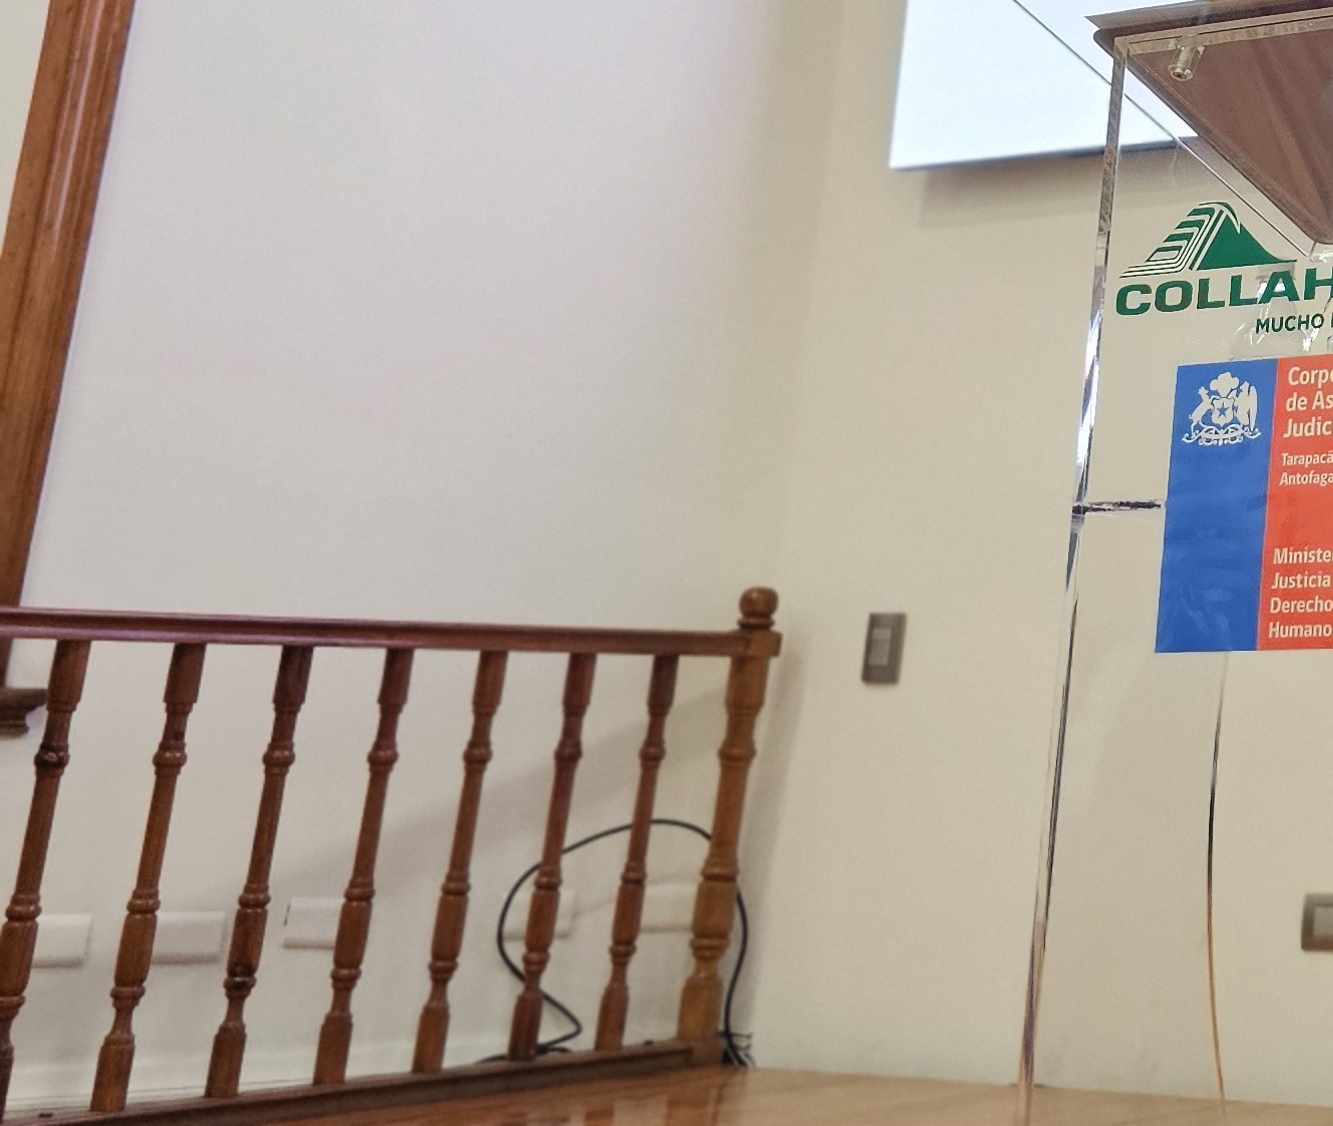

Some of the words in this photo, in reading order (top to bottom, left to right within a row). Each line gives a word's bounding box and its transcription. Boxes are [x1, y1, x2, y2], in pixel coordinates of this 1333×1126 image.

[1255, 313, 1325, 335] MUCHO
[1286, 392, 1307, 412] de
[1281, 450, 1333, 468] Tarapacá
[1271, 571, 1331, 589] Justicia
